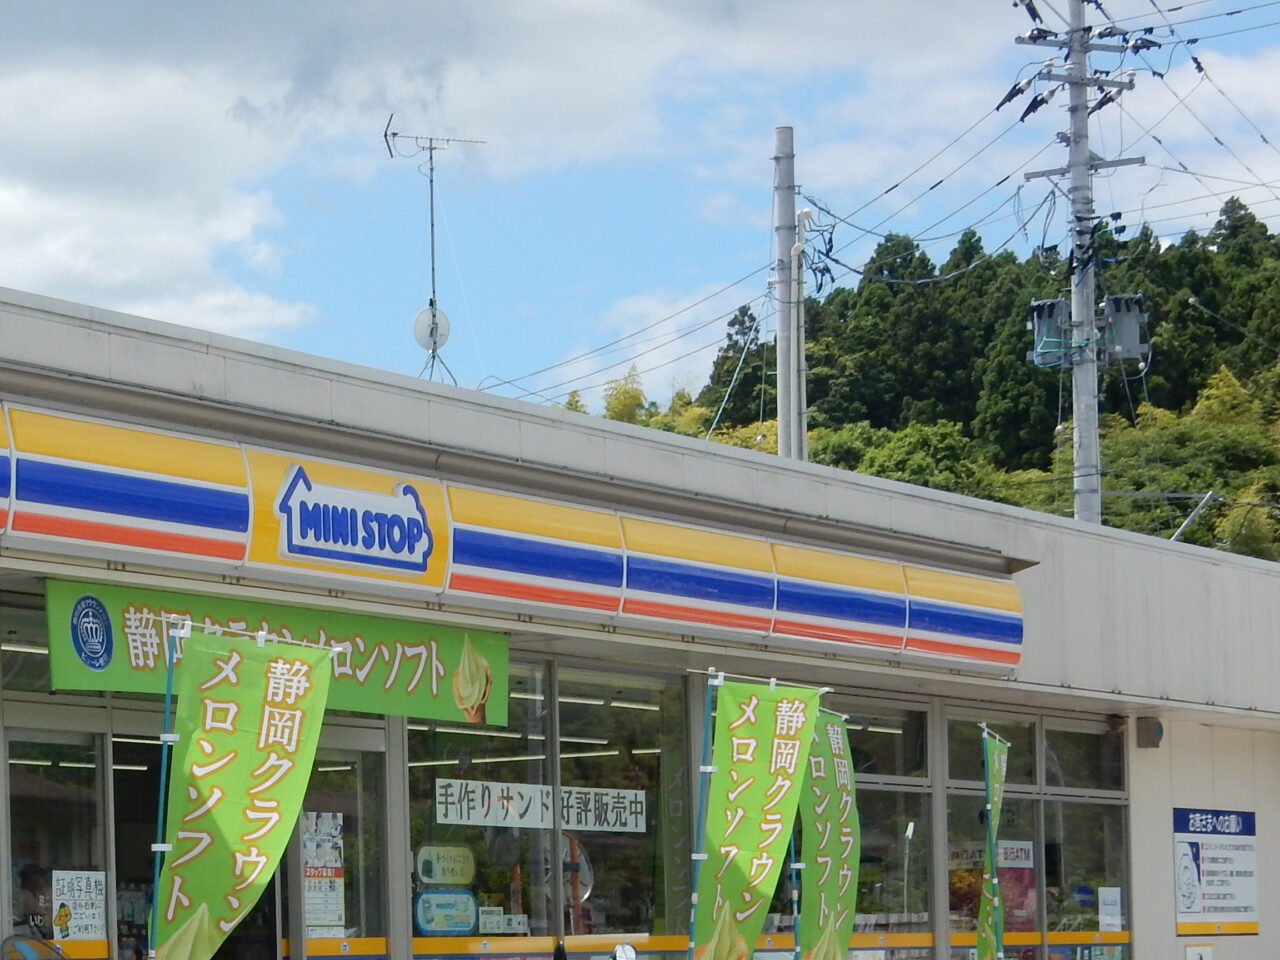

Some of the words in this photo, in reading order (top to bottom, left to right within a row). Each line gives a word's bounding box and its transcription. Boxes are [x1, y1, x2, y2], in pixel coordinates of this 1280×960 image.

[300, 500, 358, 547] MINI
[361, 510, 424, 555] STOP
[55, 875, 104, 900] 証明写真機
[167, 652, 241, 921] メロンソフト
[221, 659, 310, 933] 静岡クラウン
[713, 694, 758, 922] メロンソフト
[735, 698, 805, 923] 静岡クラウン
[810, 726, 832, 927] ロンソフト
[826, 723, 855, 931] 静岡クラウン
